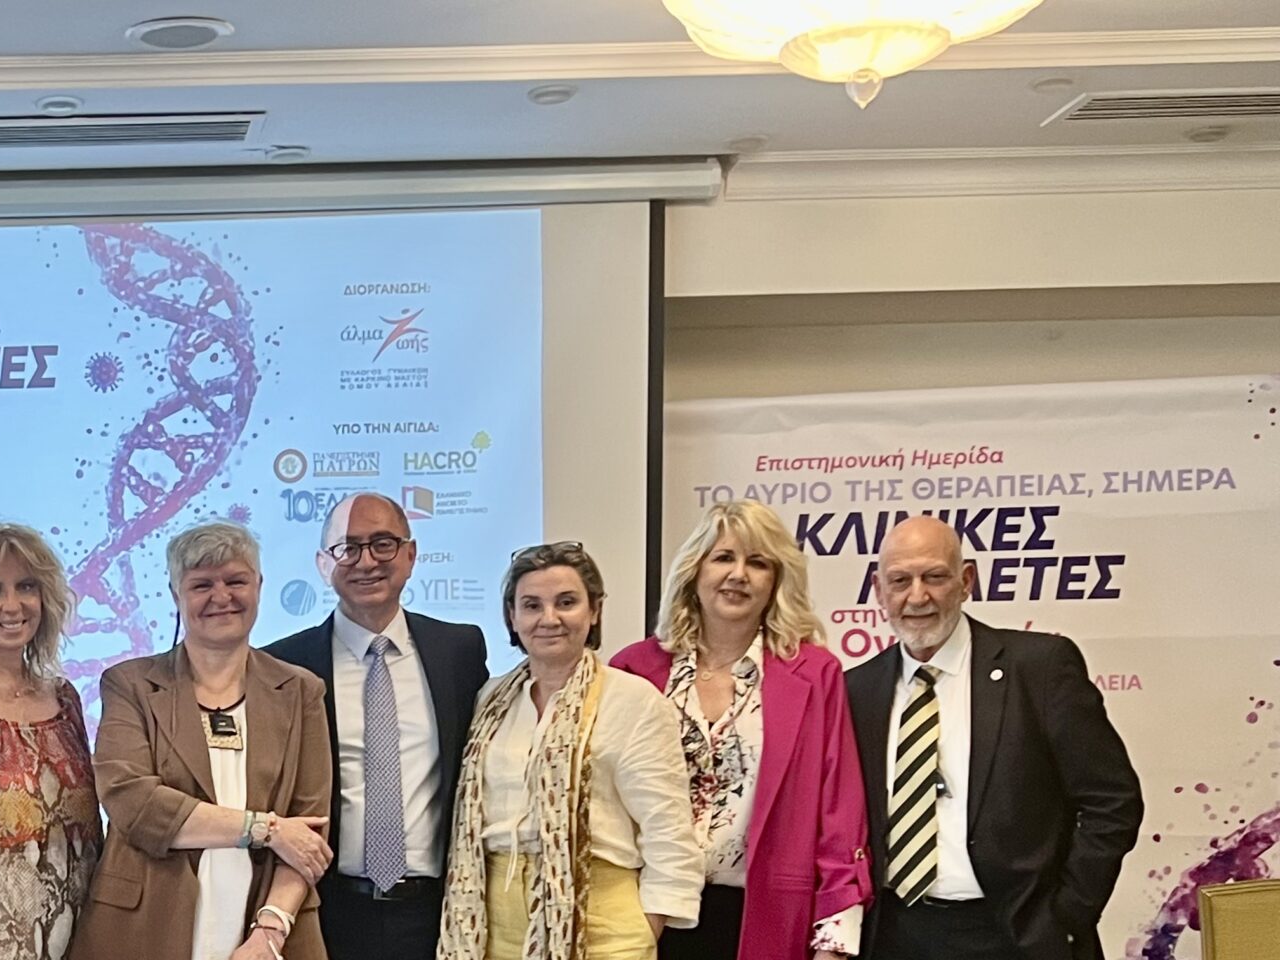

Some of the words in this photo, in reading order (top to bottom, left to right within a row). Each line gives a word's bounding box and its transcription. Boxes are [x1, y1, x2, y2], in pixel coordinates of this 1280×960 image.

[343, 282, 431, 296] ΔΙΟΡΓΑΝΩΣΗ:
[333, 424, 361, 435] ΥΠΟ
[364, 423, 391, 434] ΤΗΝ
[394, 421, 440, 433] ΑΙΓΙΔΑ:
[313, 459, 380, 472] ΠΑΤΡΩΝ
[404, 450, 477, 470] HACRO
[756, 449, 904, 474] Επιστημονική
[911, 446, 1004, 470] Ημερίδα
[694, 485, 734, 508] ΤΟ
[743, 482, 832, 506] ΑΥΡΙΟ
[846, 478, 903, 502] ΤΗΣ
[911, 472, 1094, 501] ΘΕΡΑΠΕΙΑΣ,
[1102, 467, 1237, 495] ΣΗΜΕΡΑ
[796, 506, 1060, 556] ΚΛΙΚΕΣ
